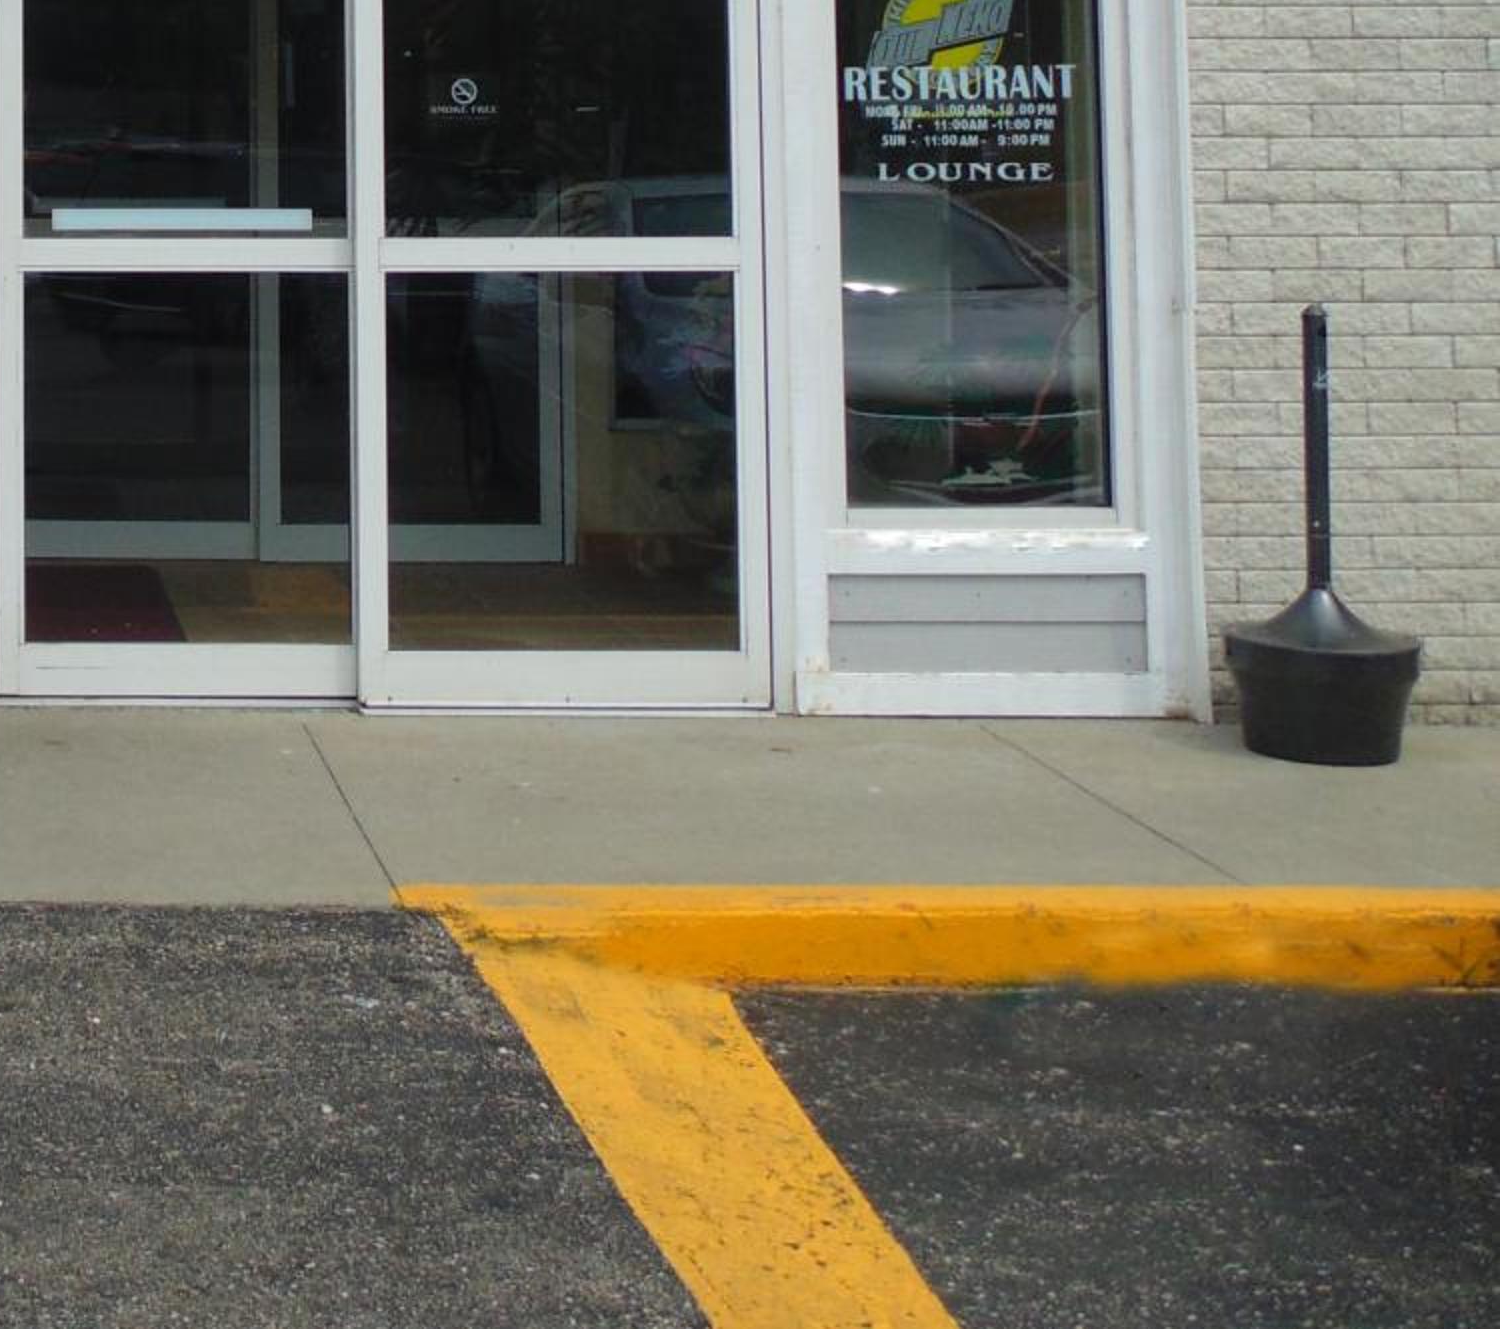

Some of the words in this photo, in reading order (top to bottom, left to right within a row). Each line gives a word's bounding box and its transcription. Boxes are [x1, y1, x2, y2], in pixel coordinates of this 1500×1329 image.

[842, 64, 1077, 102] RESTAURANT
[1037, 103, 1058, 116] PM
[891, 119, 913, 132] SAT
[1034, 118, 1055, 131] PM
[881, 134, 907, 148] SUN
[958, 134, 980, 147] AM
[1029, 134, 1051, 147] PM
[877, 161, 1056, 183] LOUNGE
